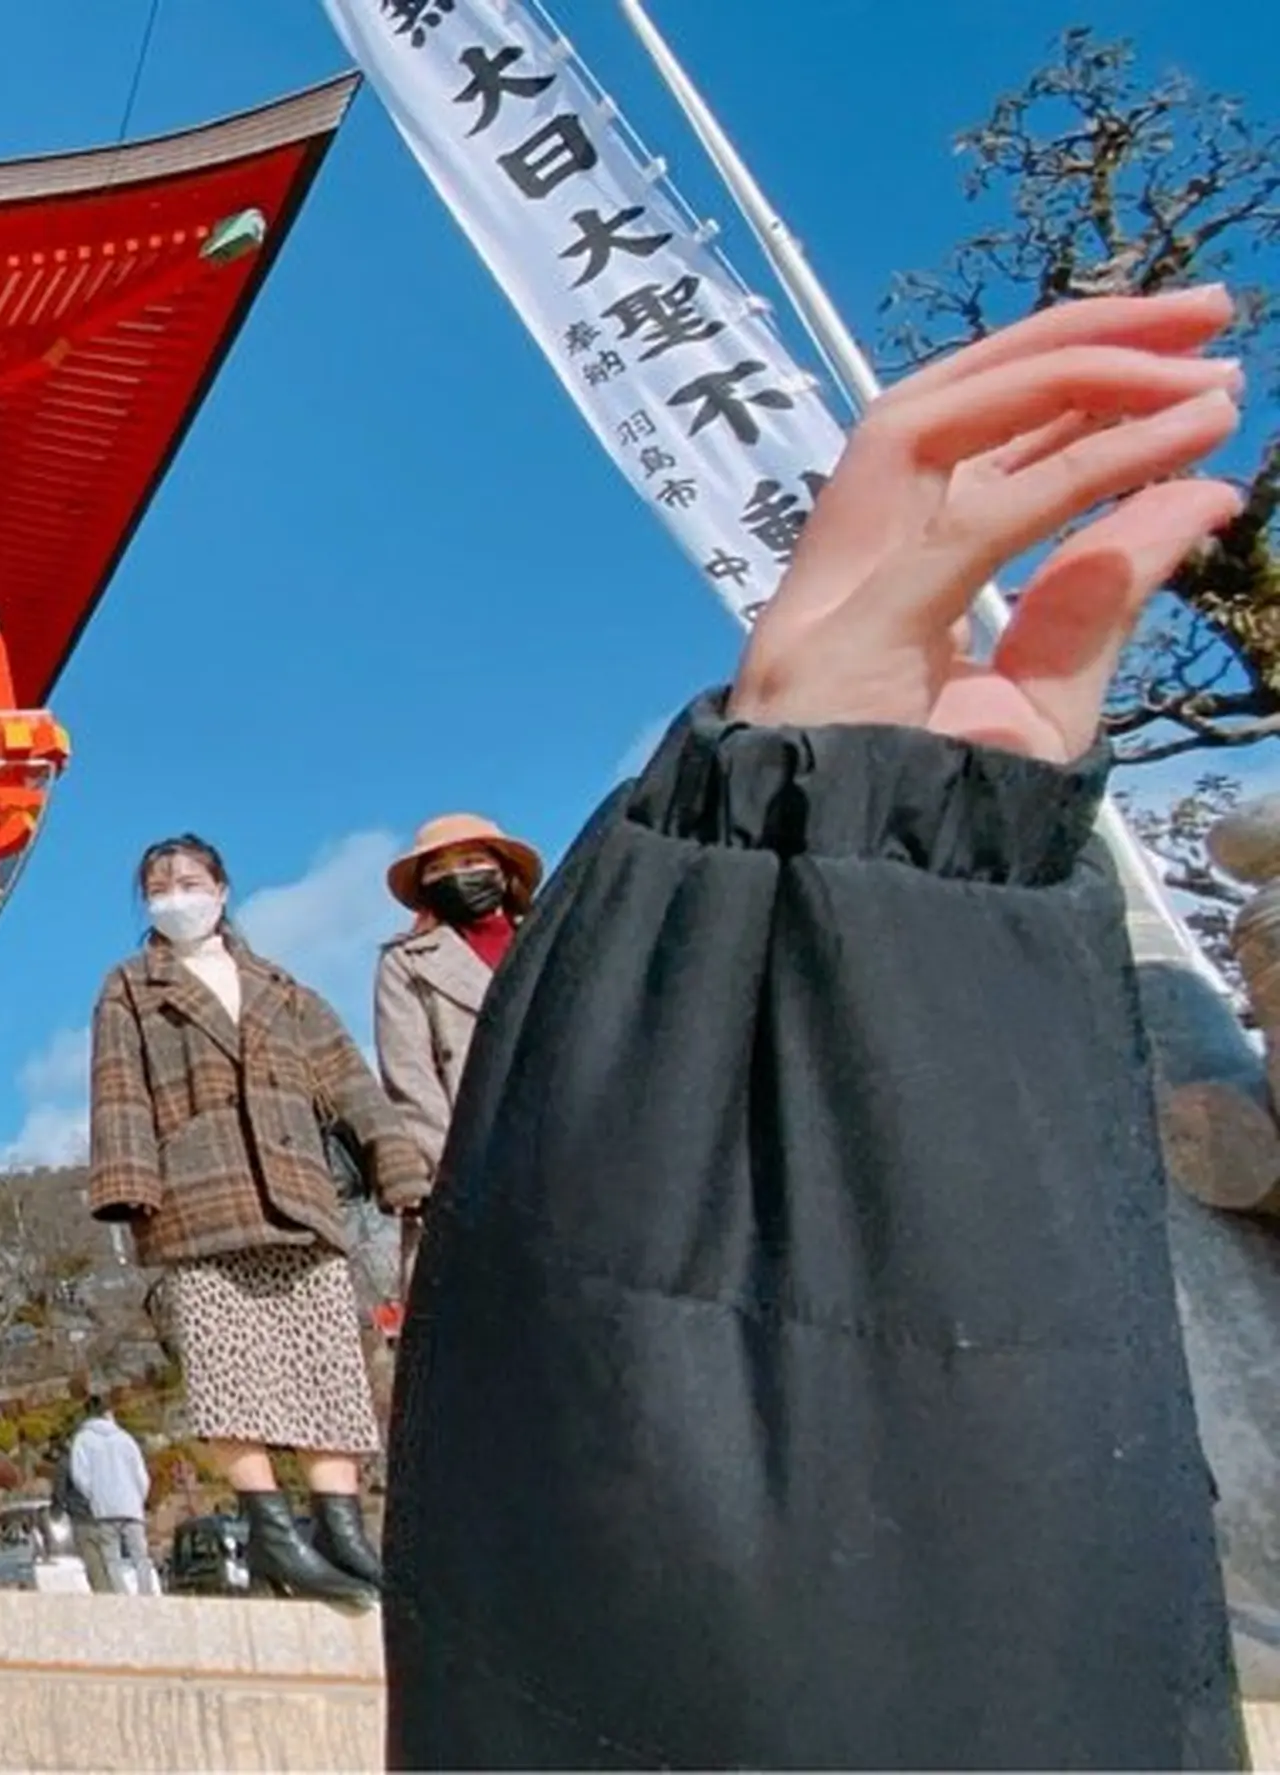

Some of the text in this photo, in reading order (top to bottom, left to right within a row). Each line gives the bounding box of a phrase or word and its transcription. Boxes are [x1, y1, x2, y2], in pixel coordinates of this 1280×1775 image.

[563, 320, 627, 387] 奉納
[616, 409, 698, 509] 羽島市
